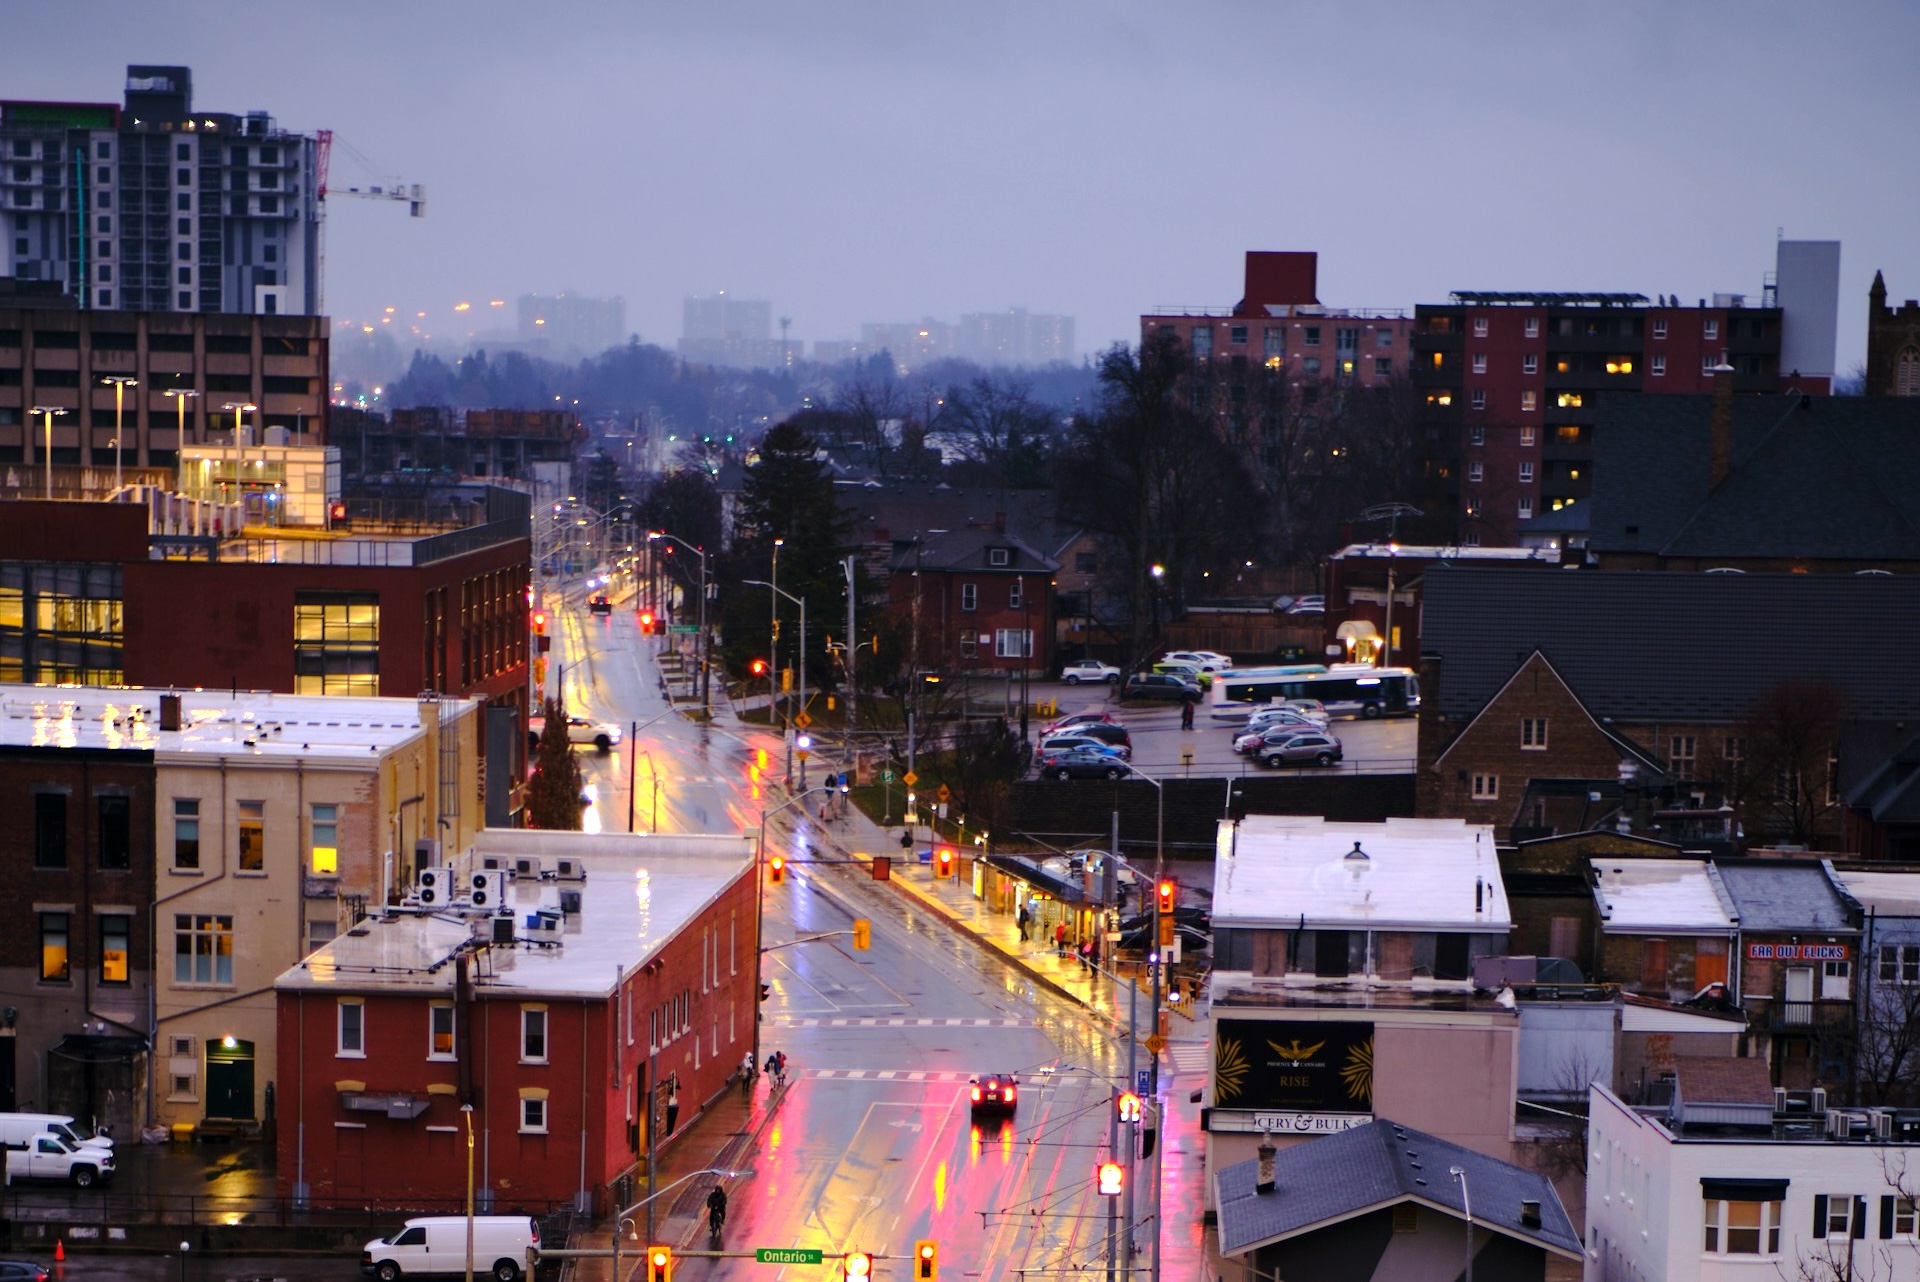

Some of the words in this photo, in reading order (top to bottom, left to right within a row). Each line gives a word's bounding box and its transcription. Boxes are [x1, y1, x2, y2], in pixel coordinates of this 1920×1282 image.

[1751, 945, 1773, 958] FAR
[1776, 945, 1800, 958] OUT
[1803, 945, 1844, 959] FLICKS
[1280, 1076, 1310, 1087] RISE
[1254, 1117, 1291, 1130] CERY
[1294, 1114, 1313, 1131] &
[1315, 1118, 1352, 1130] BULK
[763, 1251, 807, 1263] Ontario
